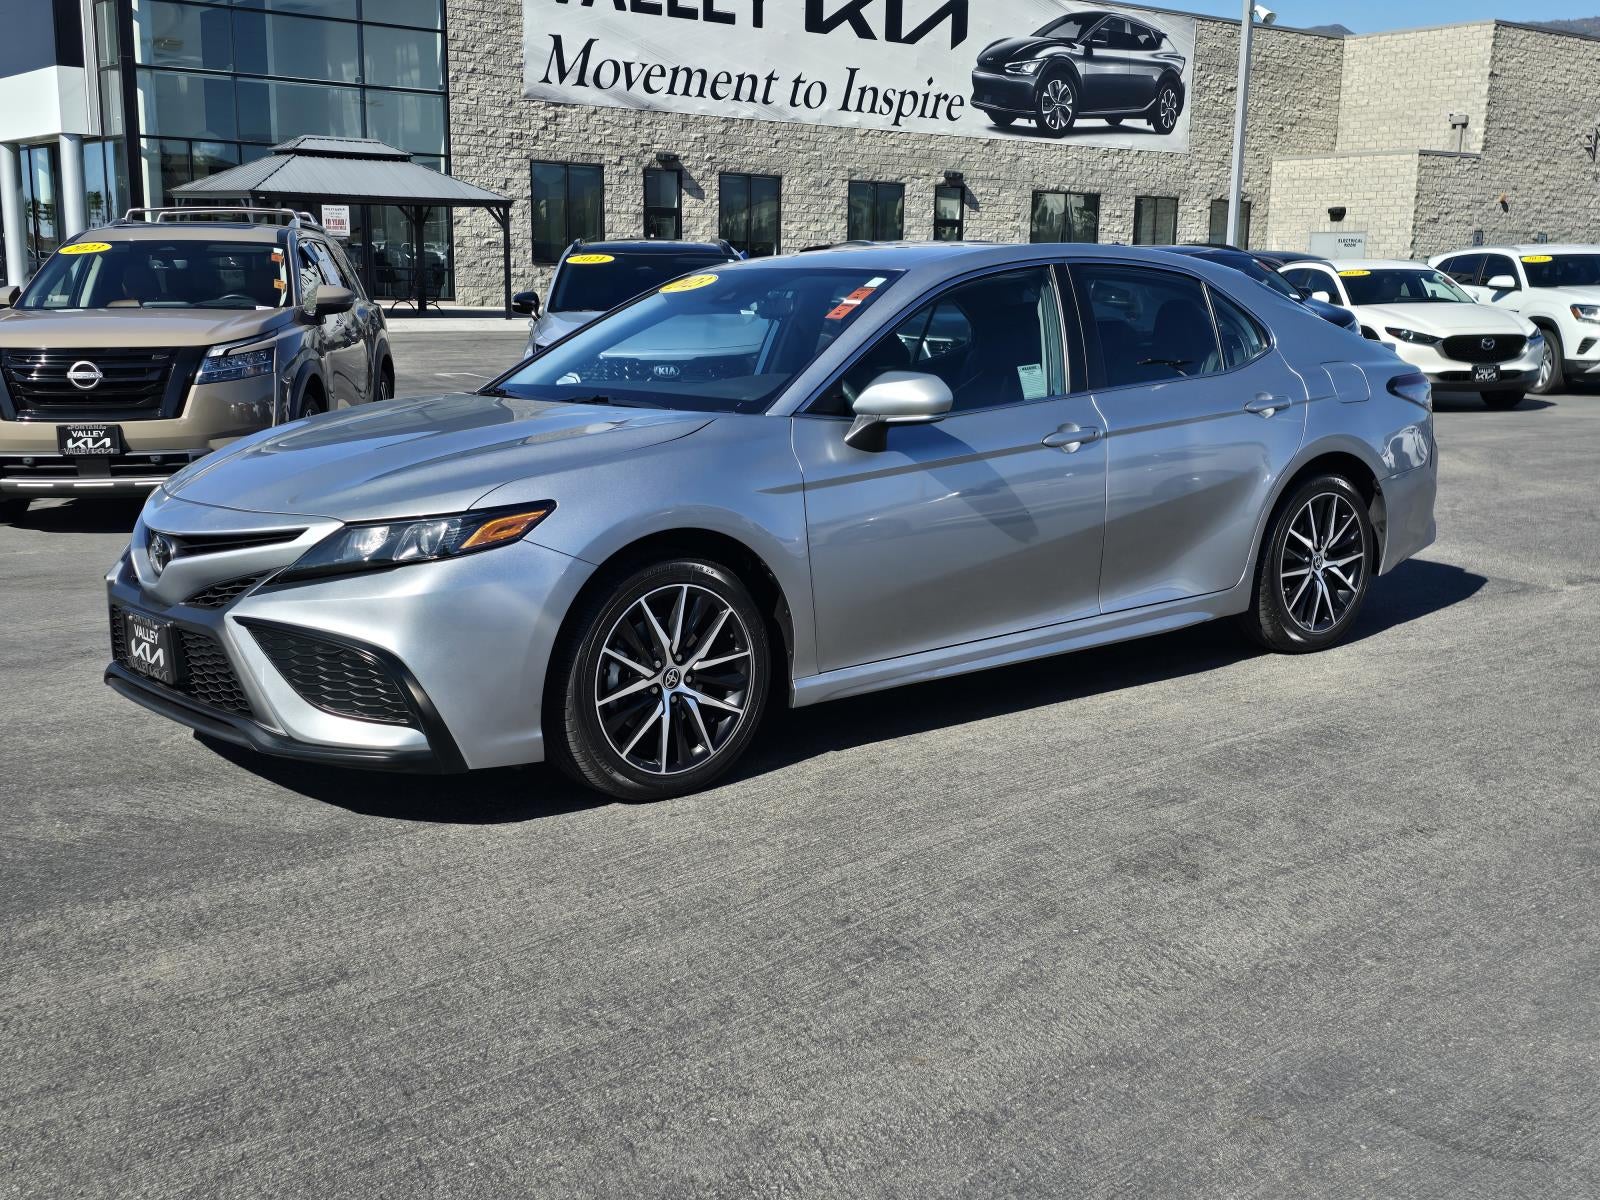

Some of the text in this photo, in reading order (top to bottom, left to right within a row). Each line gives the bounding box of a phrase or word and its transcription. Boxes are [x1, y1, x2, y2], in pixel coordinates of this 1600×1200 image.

[538, 33, 965, 127] Movement to Inspire
[66, 437, 111, 449] KIA
[71, 430, 105, 438] VALLEY
[133, 623, 159, 645] VALLEY
[131, 637, 165, 668] KIA
